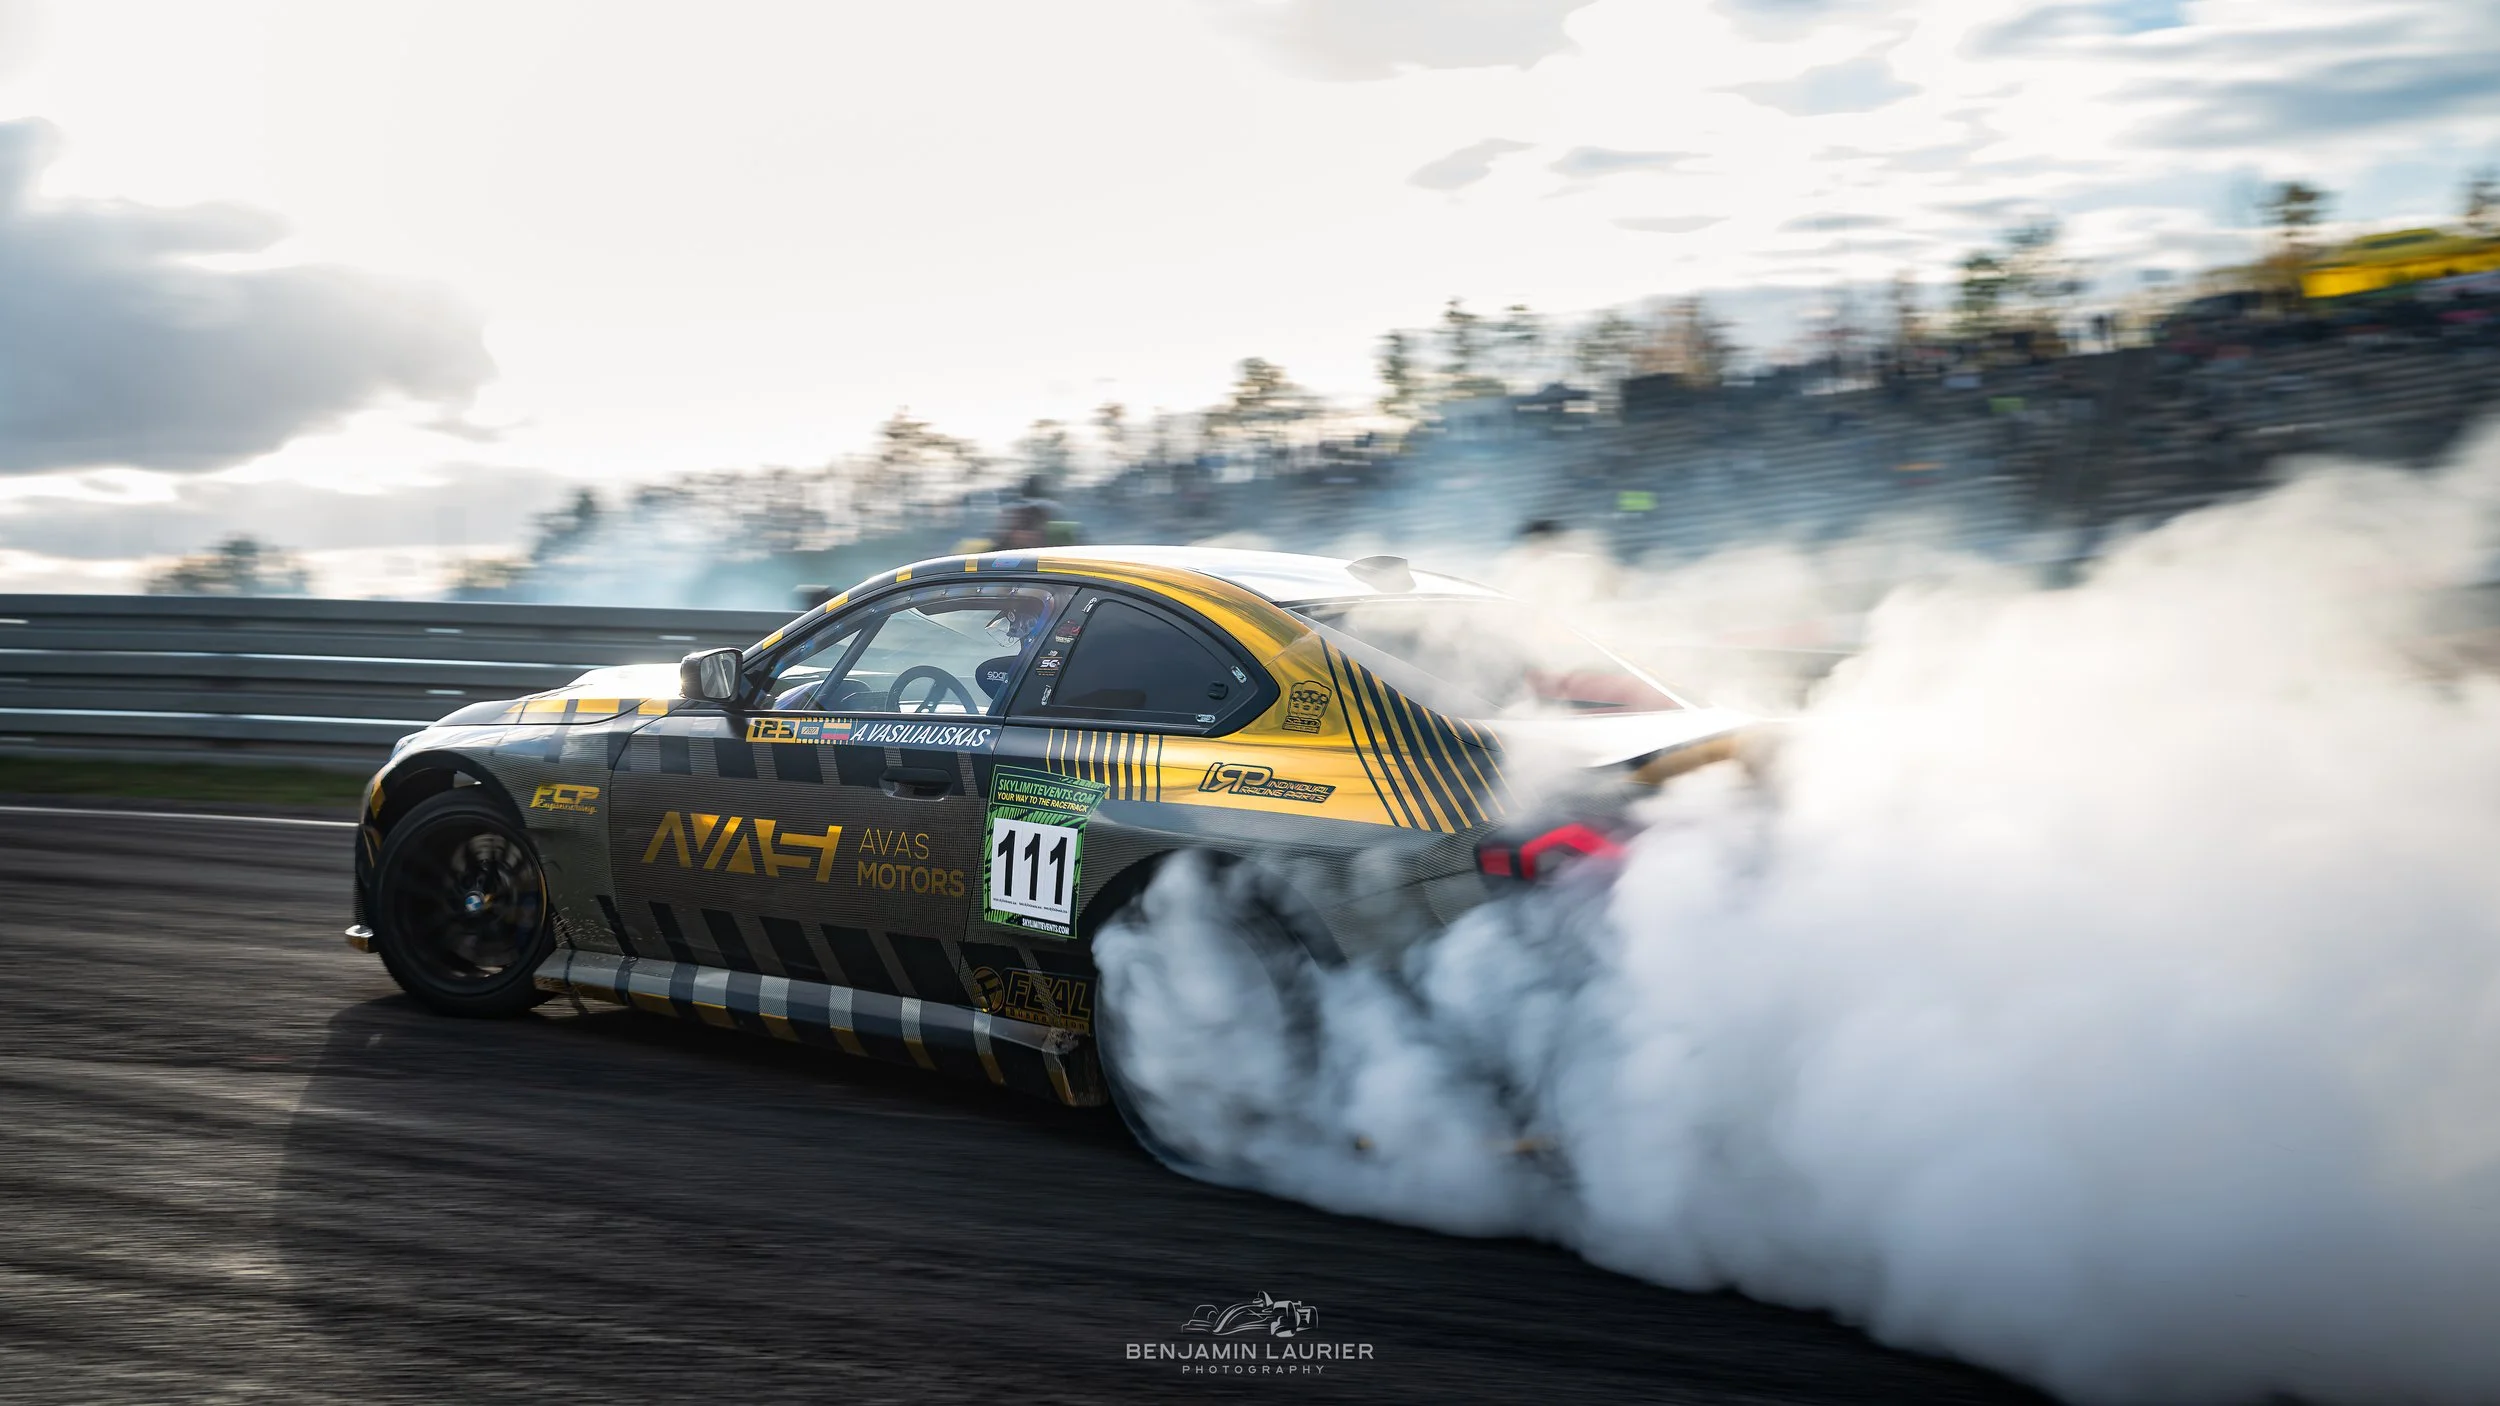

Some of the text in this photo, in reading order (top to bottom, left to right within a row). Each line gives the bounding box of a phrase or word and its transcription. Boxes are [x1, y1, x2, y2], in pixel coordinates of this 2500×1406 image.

[752, 720, 799, 739] 123
[851, 724, 991, 747] A.VASILIAUSKAS
[530, 783, 600, 808] FCP
[998, 779, 1095, 804] SKYLIMITEVENTS.COM
[1240, 785, 1326, 802] RACING PARTS
[1267, 779, 1333, 795] INDIVIDUAL
[997, 791, 1089, 812] YOUR WAY TO THE RACETRACK
[858, 828, 930, 860] AVAS
[857, 860, 966, 898] MOTORS
[997, 829, 1068, 906] 111
[1022, 918, 1069, 935] SKYLIMITEVENTS.COM
[1005, 971, 1091, 1021] FEAL
